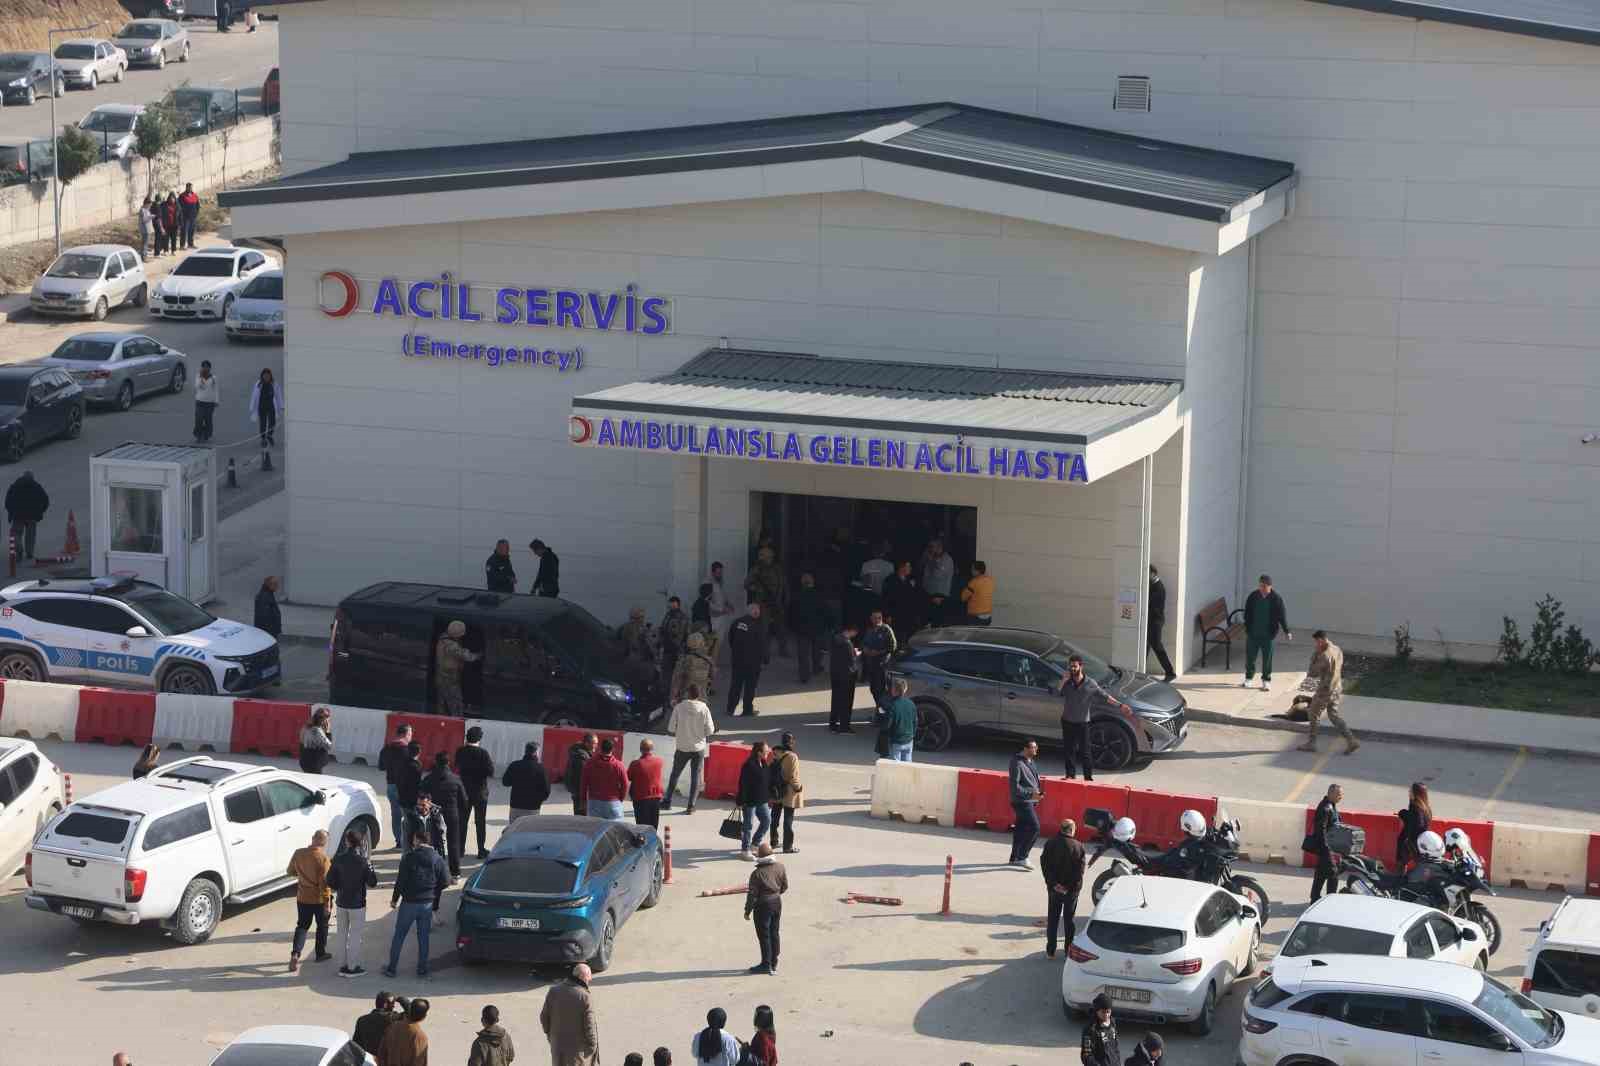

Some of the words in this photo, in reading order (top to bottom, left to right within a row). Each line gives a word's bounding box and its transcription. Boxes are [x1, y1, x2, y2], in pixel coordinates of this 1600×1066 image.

[374, 272, 482, 322] ACİL
[496, 284, 668, 335] SERVİS
[402, 332, 584, 372] (Emergency)
[597, 418, 801, 461] AMBULANSLA
[809, 434, 906, 469] GELEN
[913, 433, 981, 475] ACİL
[987, 446, 1089, 482] HASTA
[97, 655, 139, 672] POLİS
